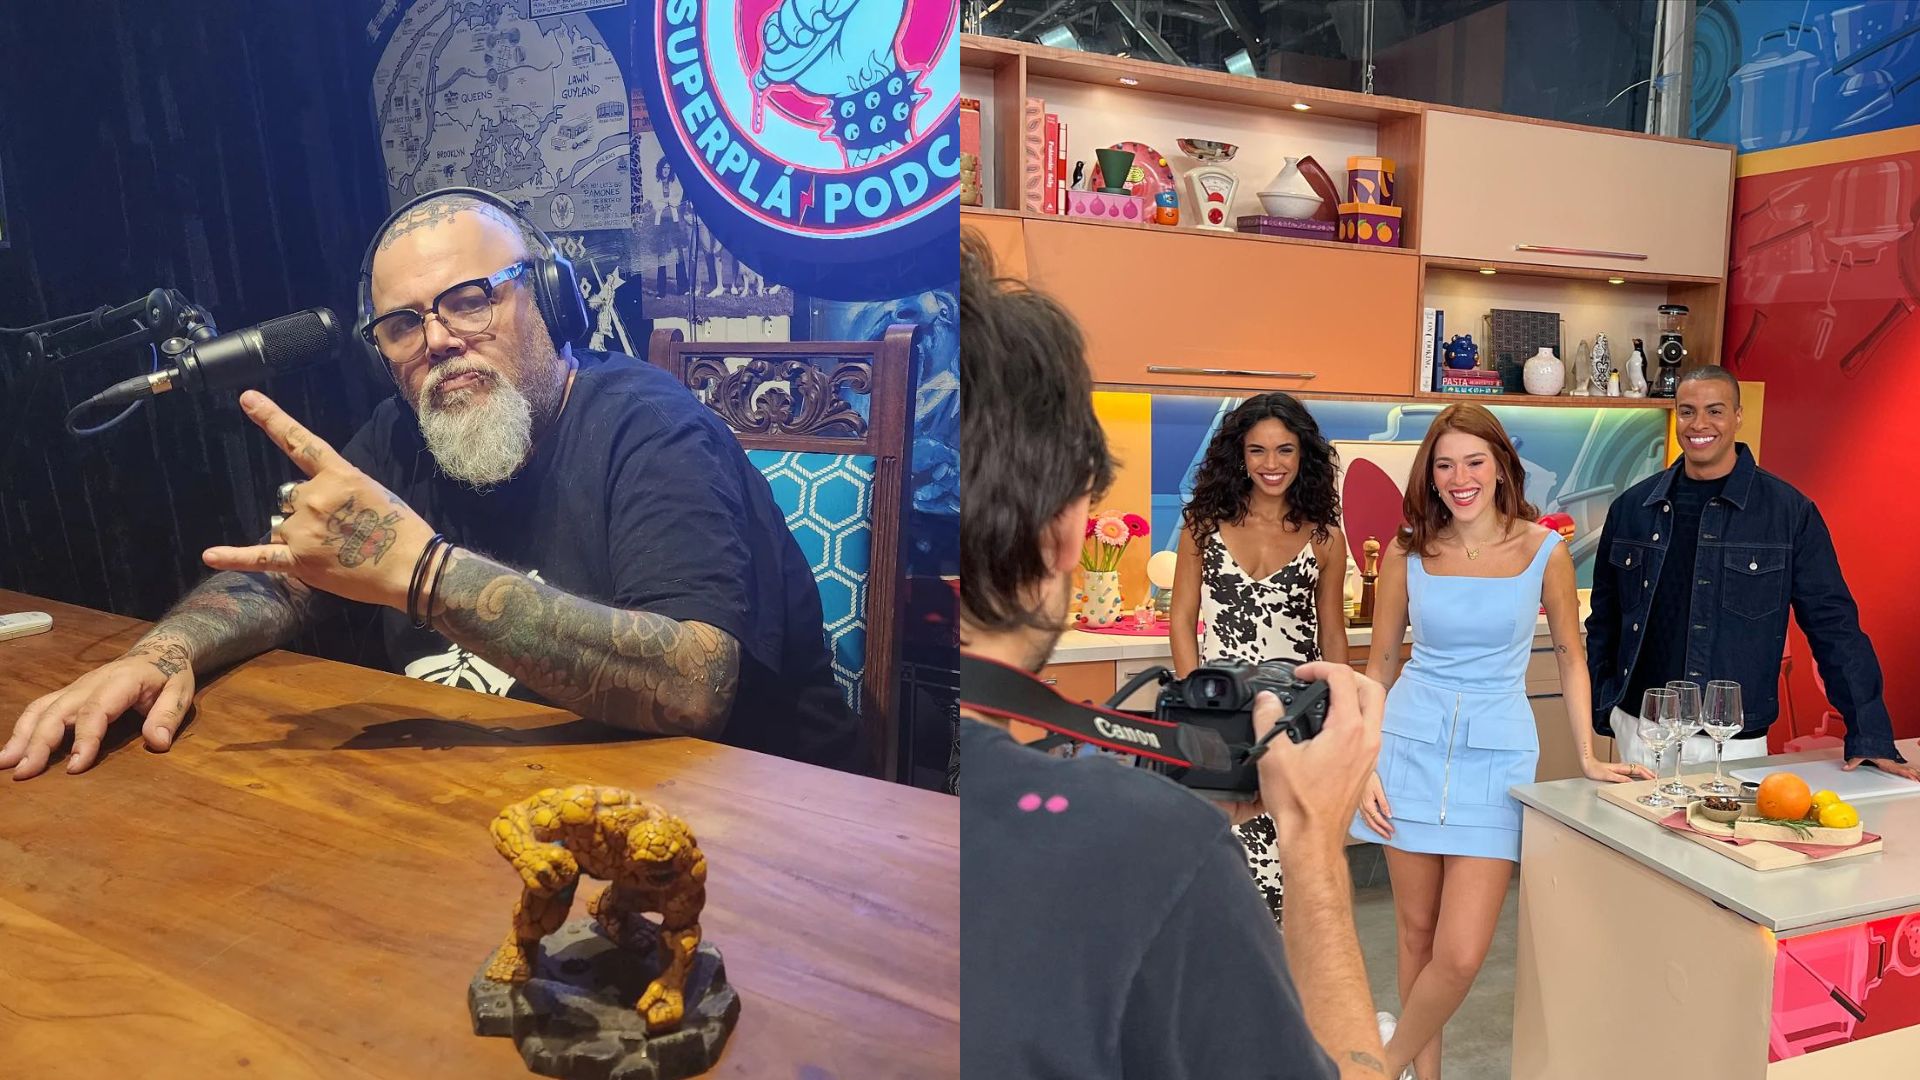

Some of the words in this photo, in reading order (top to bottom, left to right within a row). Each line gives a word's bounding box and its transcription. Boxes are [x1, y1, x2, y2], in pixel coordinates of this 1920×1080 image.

[567, 70, 590, 86] LAWN
[461, 89, 493, 103] QUEENS
[561, 84, 601, 99] GUYLAND
[666, 0, 795, 217] SUPERPLÁ
[824, 132, 960, 224] PODC
[436, 146, 466, 159] BROOKLYN
[1442, 377, 1468, 386] PASTA
[1093, 716, 1161, 749] Canon
